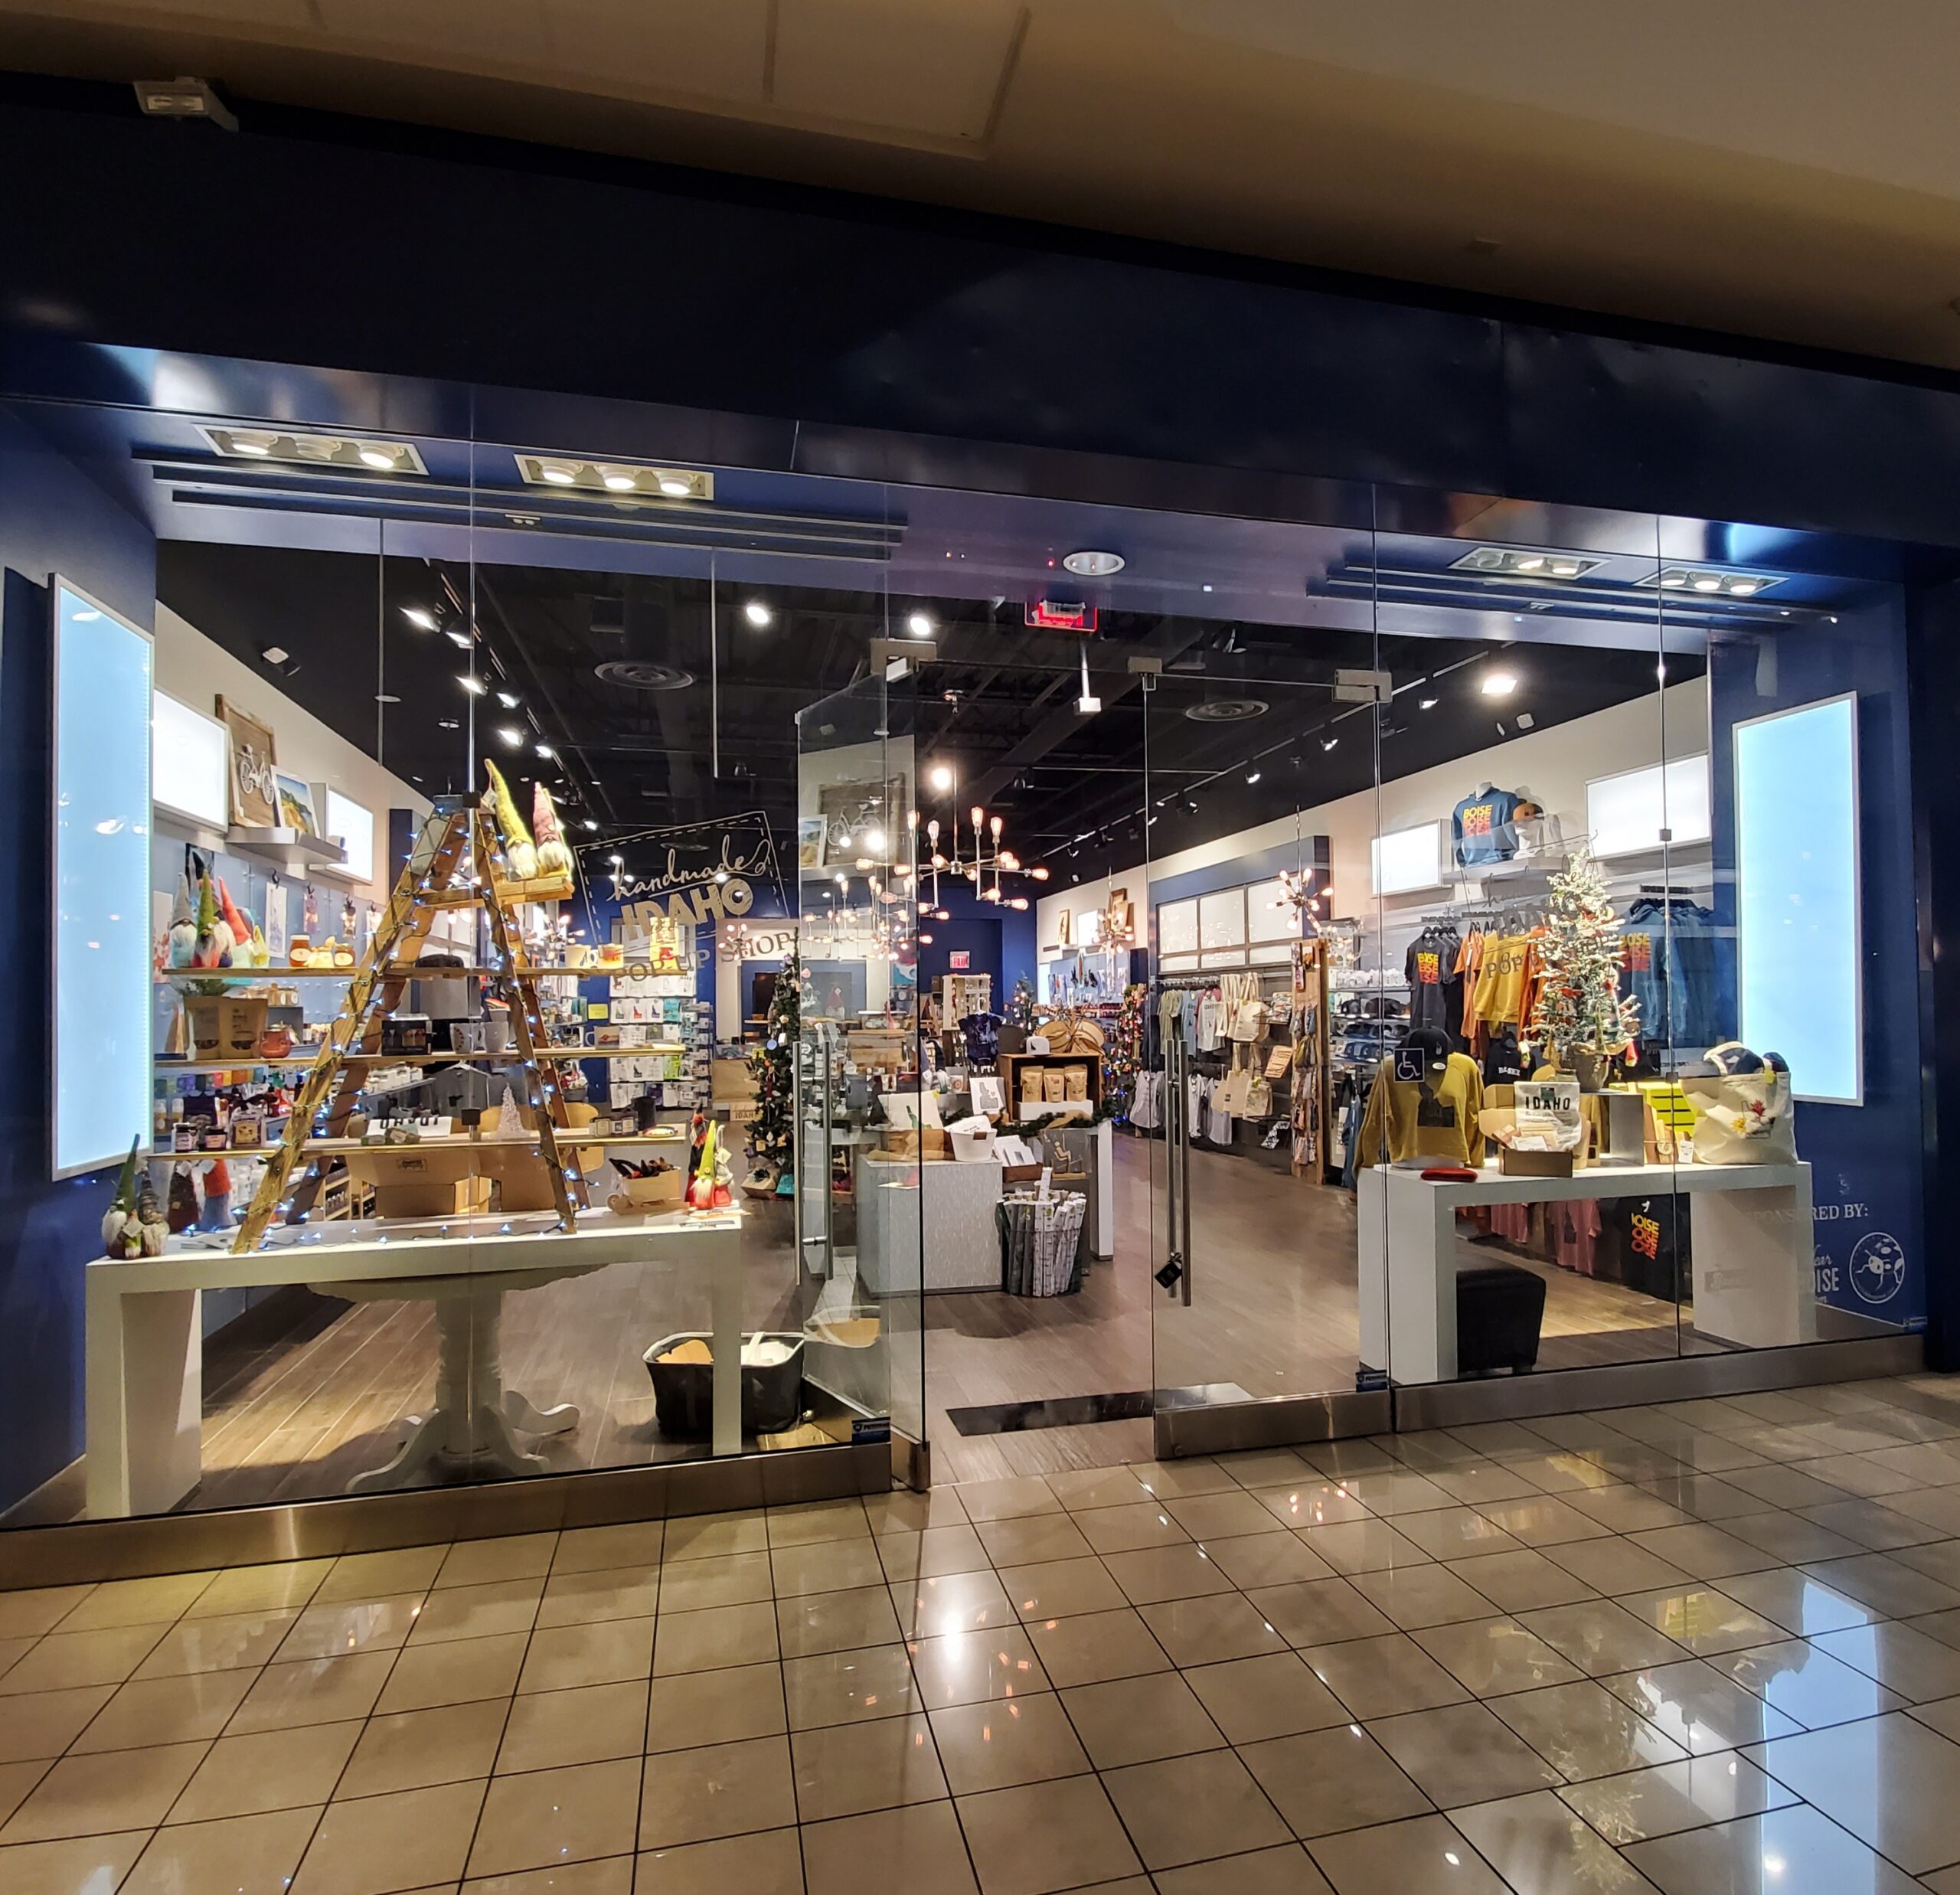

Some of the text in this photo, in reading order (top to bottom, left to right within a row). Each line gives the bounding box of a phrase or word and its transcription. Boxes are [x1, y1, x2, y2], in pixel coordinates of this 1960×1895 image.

[1463, 804, 1493, 819] BOISE
[606, 834, 771, 901] handmade
[620, 878, 754, 941] IDAHO
[719, 932, 794, 963] SHOP
[1525, 1096, 1571, 1111] IDAHO
[735, 1110, 755, 1119] IDAH
[1843, 1202, 1870, 1219] BY:
